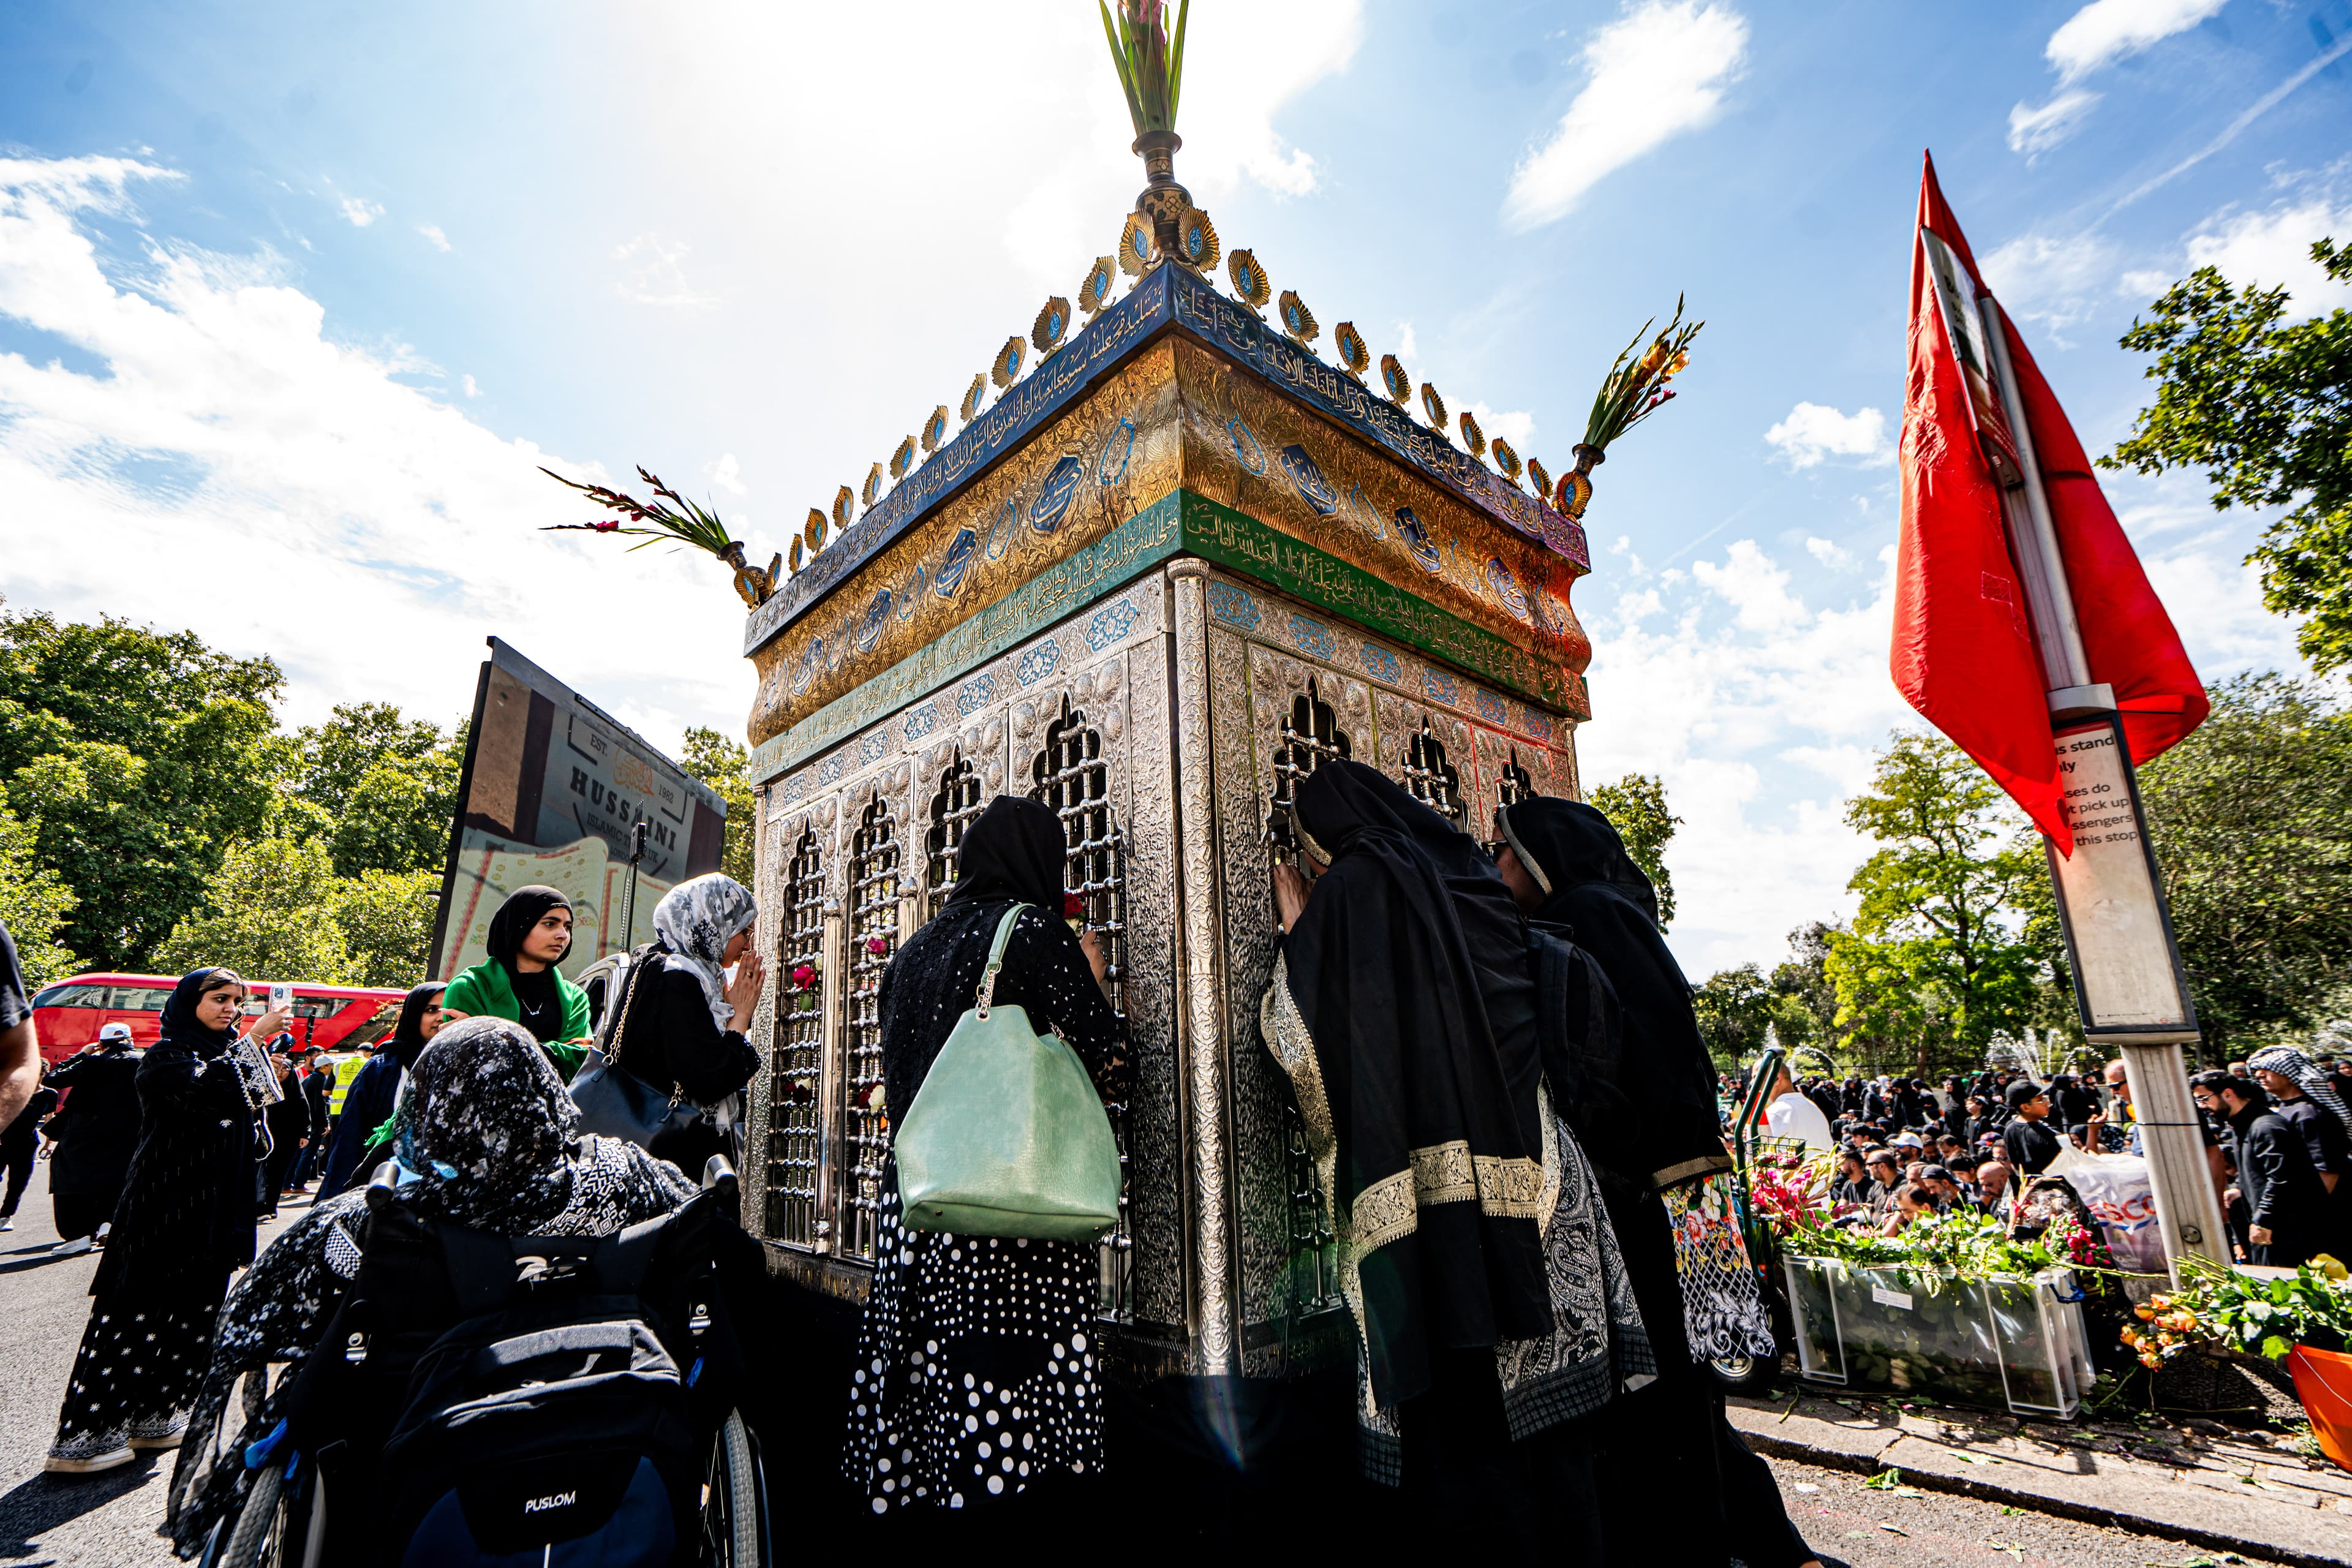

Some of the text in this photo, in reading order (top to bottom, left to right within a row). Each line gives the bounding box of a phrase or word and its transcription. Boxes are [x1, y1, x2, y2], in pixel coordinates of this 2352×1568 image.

[590, 733, 608, 757] EST.
[2070, 735, 2115, 752] stand
[658, 784, 674, 804] 1982
[2065, 783, 2111, 798] ses do
[2079, 800, 2107, 815] pick
[2111, 798, 2130, 809] up
[587, 813, 623, 842] ISLAMIC
[2071, 815, 2133, 830] ssengers
[2076, 831, 2138, 846] this stop
[648, 849, 659, 864] UK
[525, 1490, 576, 1513] PUSLOM
